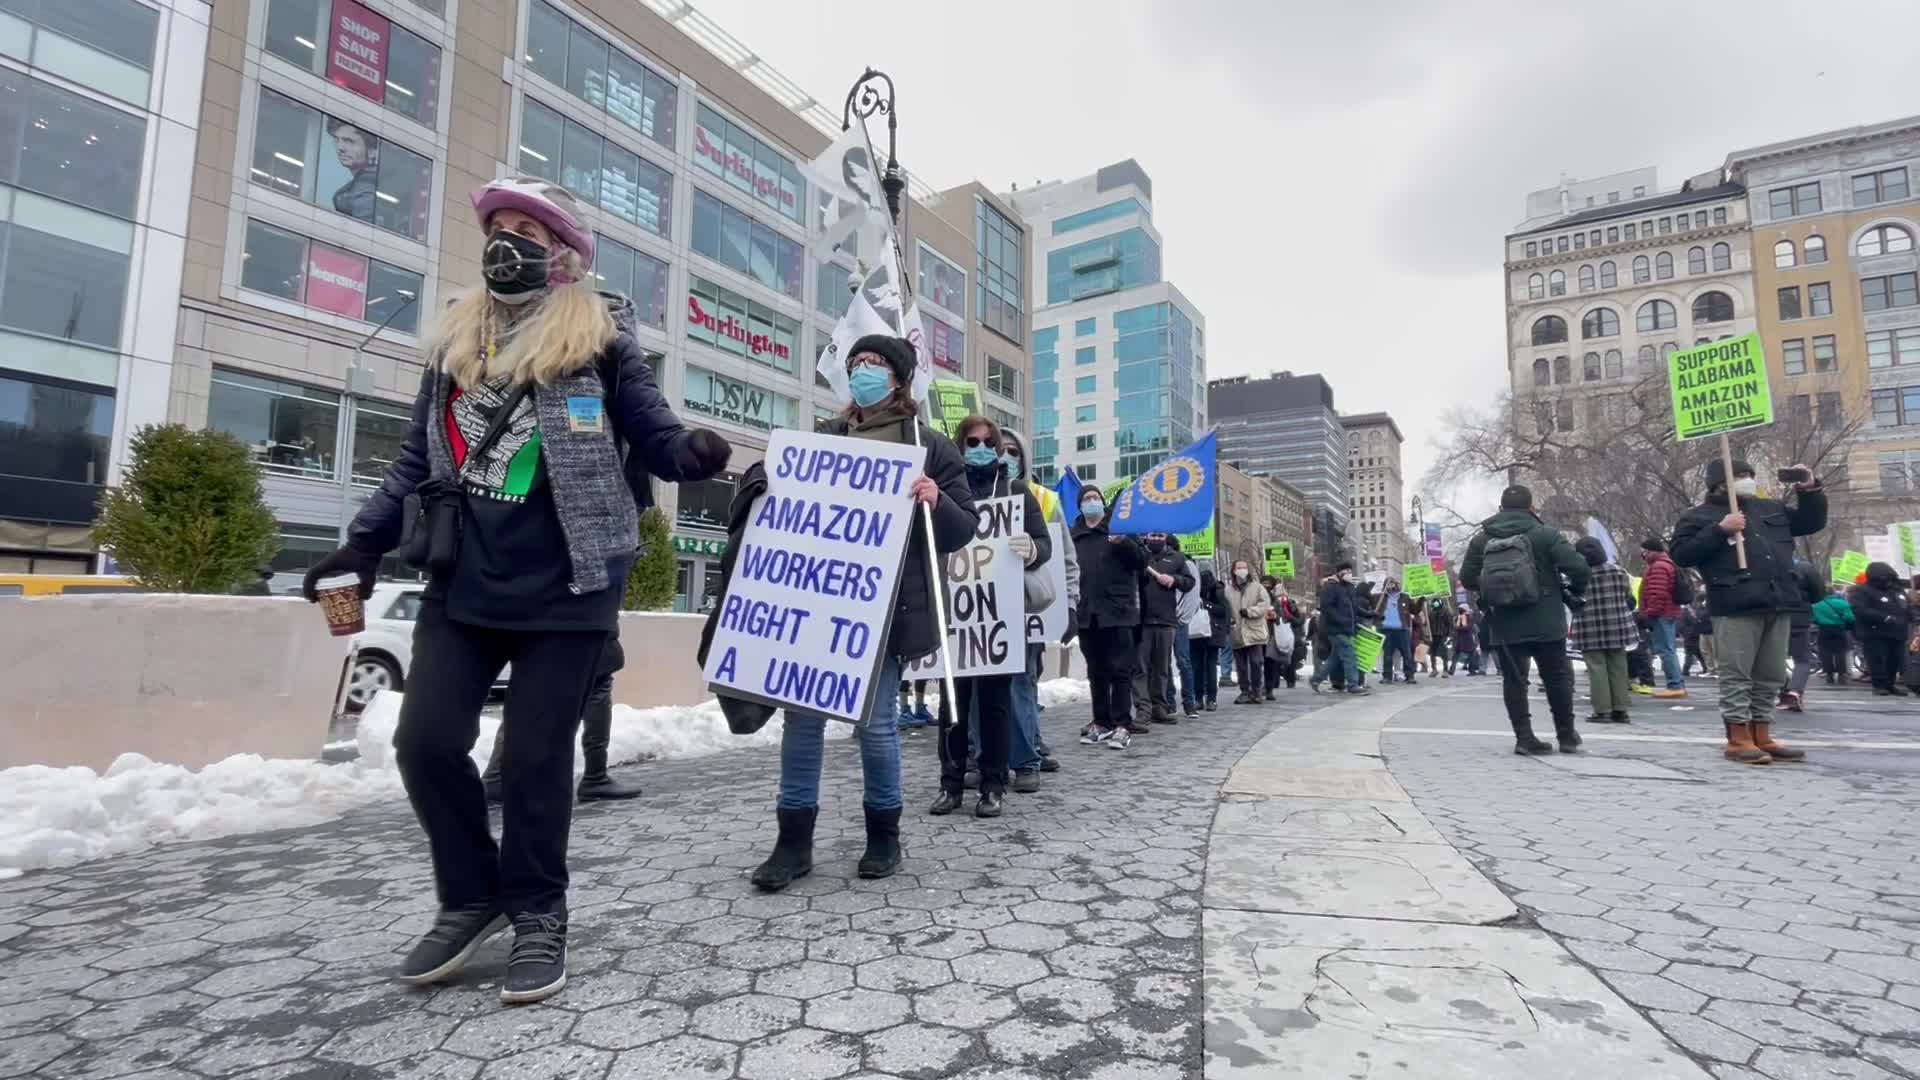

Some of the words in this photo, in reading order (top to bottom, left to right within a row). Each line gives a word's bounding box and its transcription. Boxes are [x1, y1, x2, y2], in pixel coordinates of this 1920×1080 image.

[341, 15, 380, 43] SHOP
[338, 34, 379, 64] SAVE
[1677, 339, 1750, 371] SUPPORT
[1678, 358, 1756, 390] ALABAMA
[707, 375, 764, 416] DSW
[1681, 379, 1758, 410] AMAZON
[1691, 399, 1752, 426] UNON
[776, 445, 912, 495] SUPPORT
[756, 495, 892, 547] AMAZON
[742, 543, 883, 602] WORKERS
[949, 545, 994, 582] OP
[951, 581, 998, 623] ON
[720, 594, 810, 645] RIGHT
[830, 616, 870, 659] TO
[715, 646, 737, 683] A
[763, 657, 861, 714] UNION
